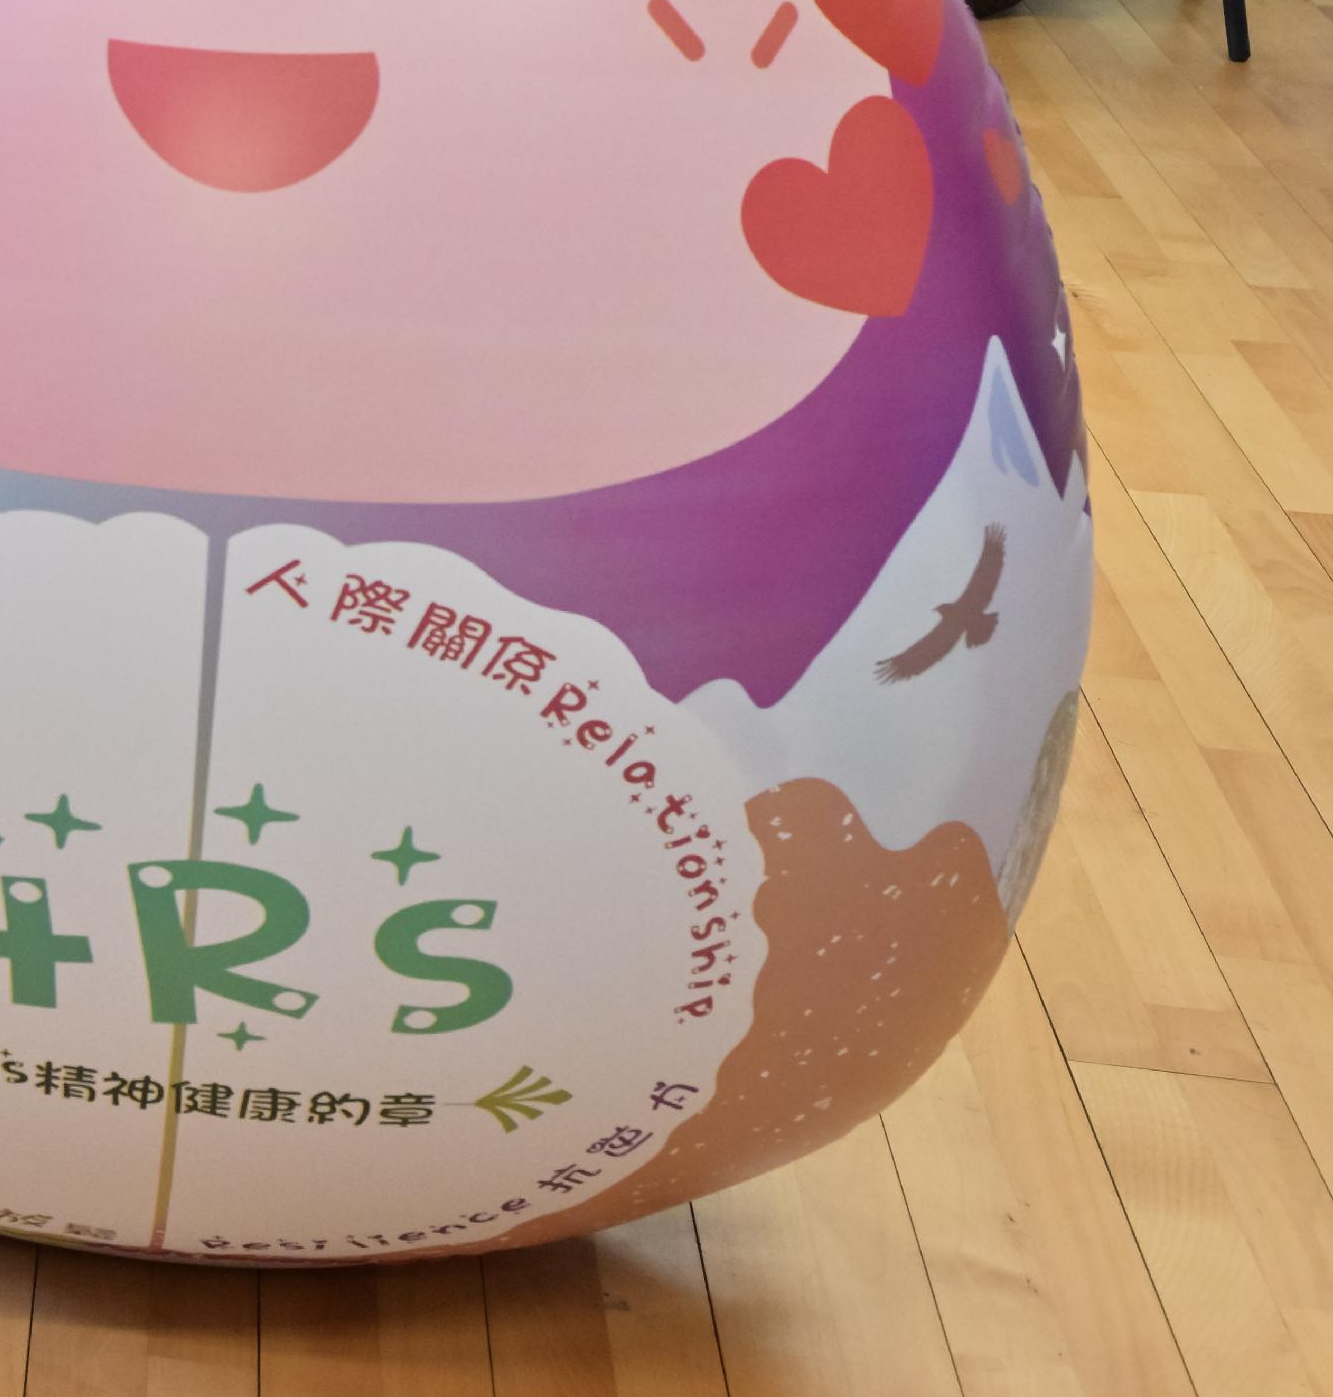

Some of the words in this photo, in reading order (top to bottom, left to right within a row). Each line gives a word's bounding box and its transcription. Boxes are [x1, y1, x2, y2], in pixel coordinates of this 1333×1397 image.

[245, 558, 557, 697] 人際關係
[540, 680, 728, 1021] Relationship
[538, 1080, 699, 1194] 抗逆力
